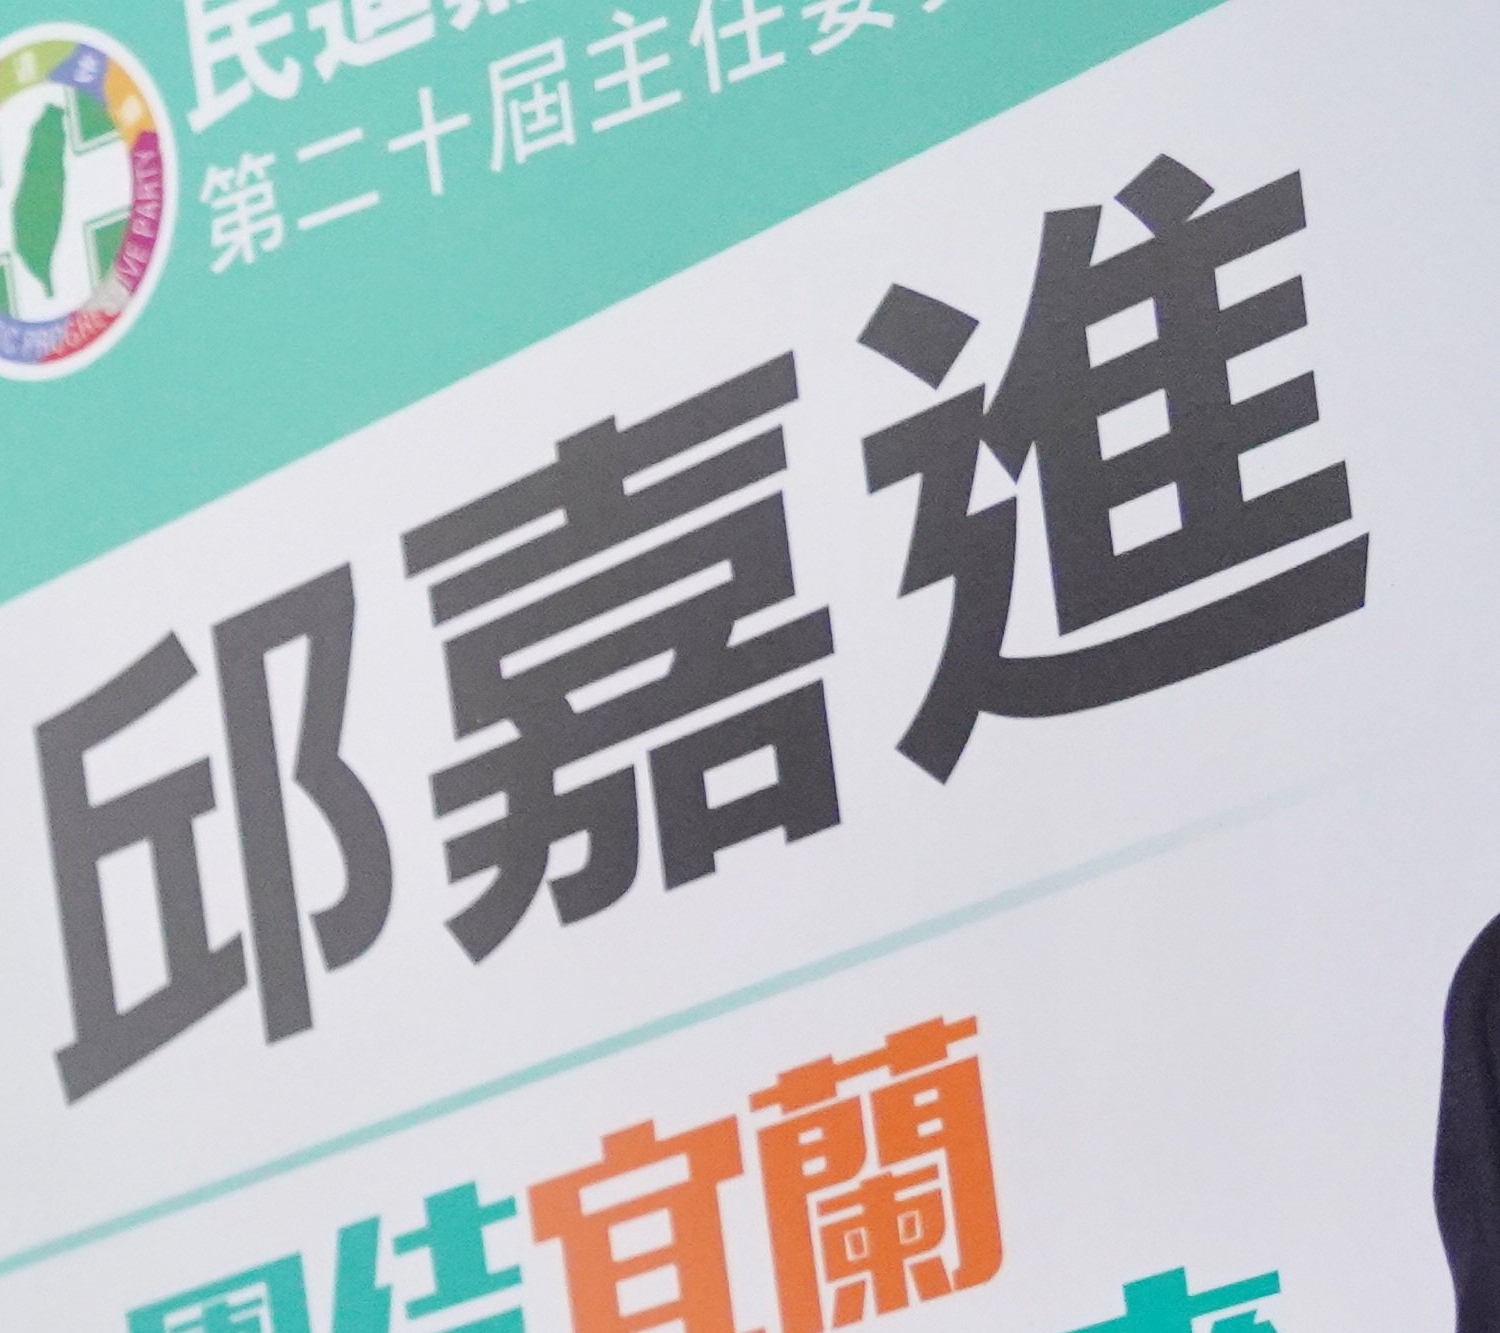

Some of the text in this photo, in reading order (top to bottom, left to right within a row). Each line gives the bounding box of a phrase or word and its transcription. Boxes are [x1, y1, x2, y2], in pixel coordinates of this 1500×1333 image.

[185, 0, 527, 134] 民進
[33, 154, 1369, 1104] 邱嘉進
